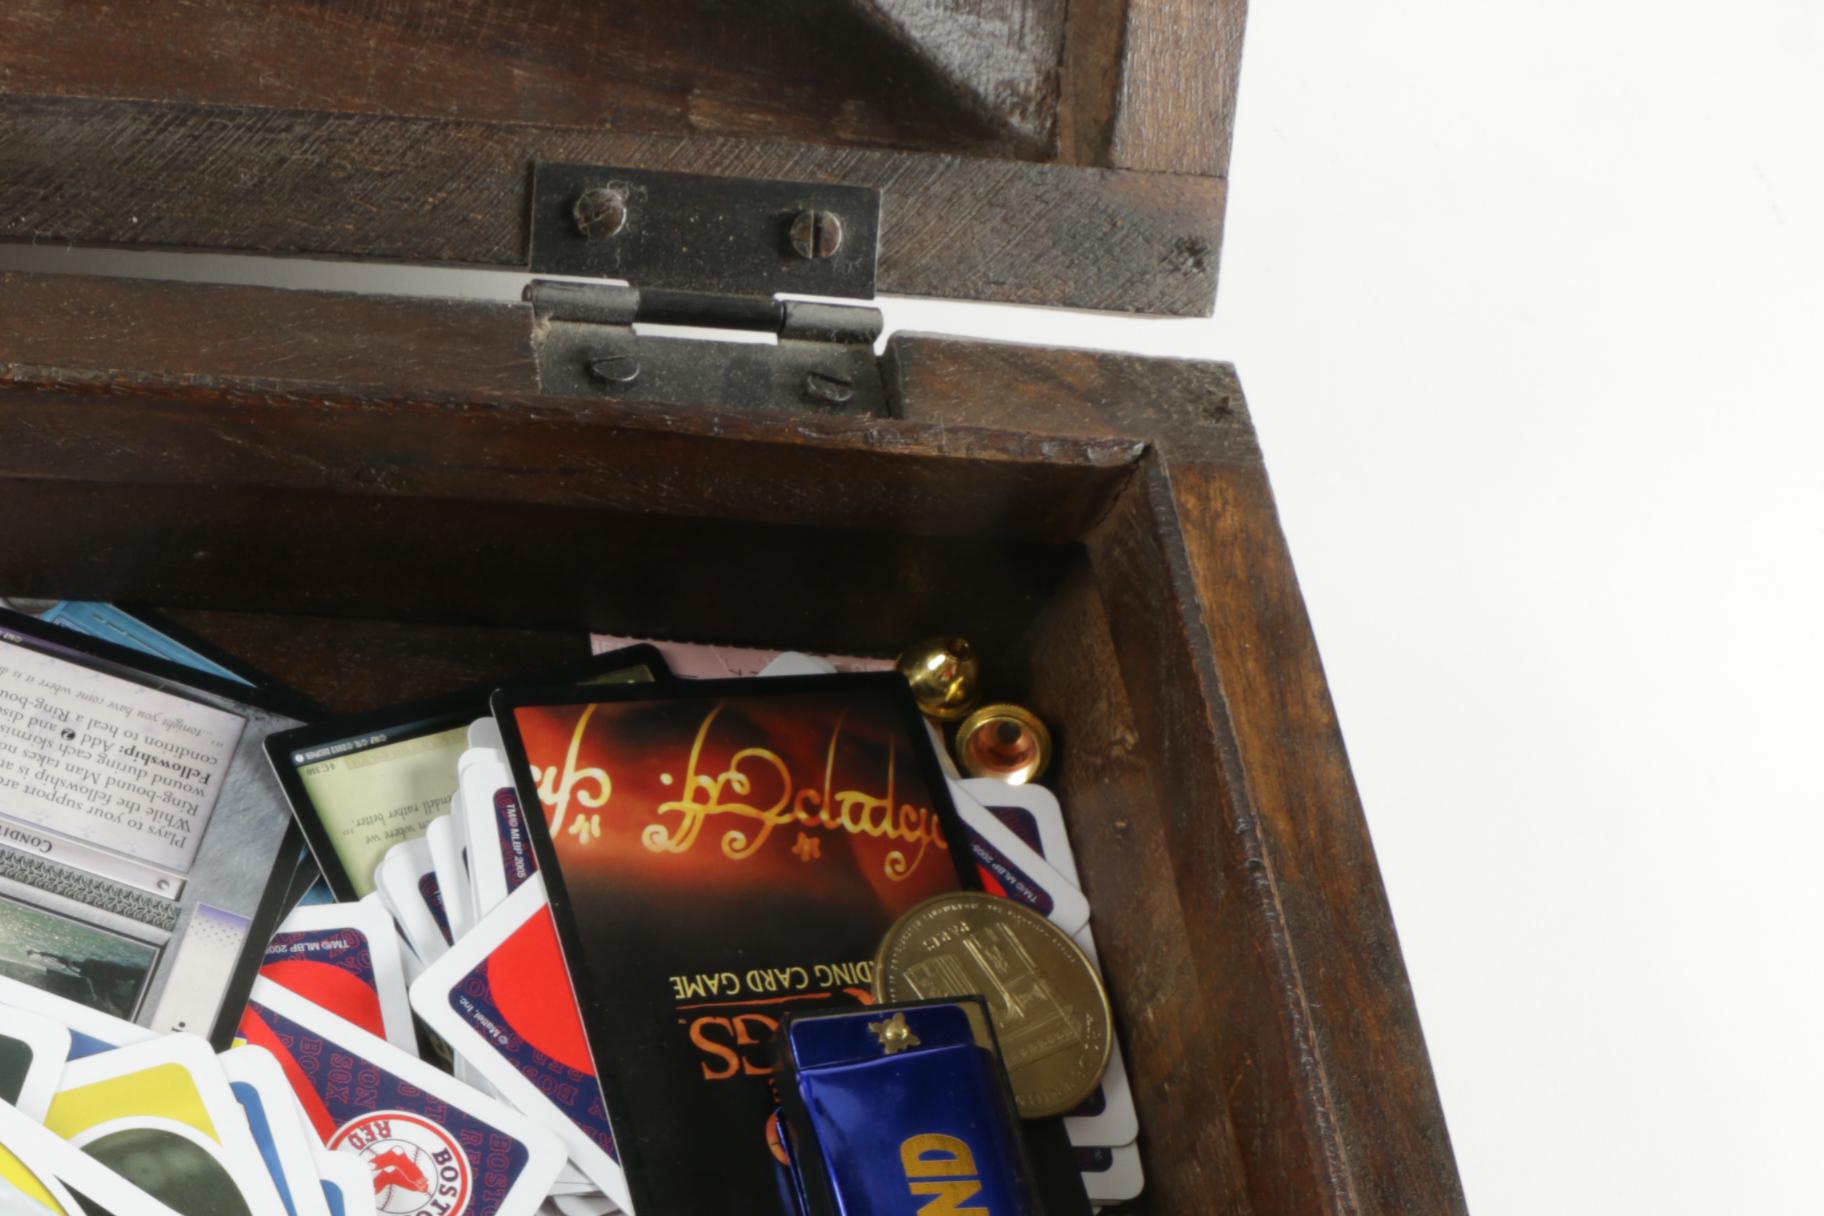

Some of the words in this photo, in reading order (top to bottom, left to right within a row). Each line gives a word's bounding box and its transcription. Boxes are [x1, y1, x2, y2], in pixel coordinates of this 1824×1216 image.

[38, 680, 71, 695] where
[75, 691, 104, 704] come
[106, 702, 133, 718] have
[137, 710, 160, 723] you
[27, 717, 57, 731] and
[86, 718, 119, 738] heal
[80, 734, 115, 753] Add
[123, 730, 138, 741] to
[23, 750, 60, 768] takes
[58, 743, 92, 760] each
[145, 736, 218, 770] condition
[0, 759, 14, 770] at
[18, 766, 30, 779] is
[65, 763, 101, 784] Man
[96, 753, 148, 782] during
[120, 746, 212, 786] Fellowship:
[34, 769, 112, 806] fellowship
[151, 774, 205, 798] wound
[23, 784, 83, 810] support
[105, 777, 200, 819] Ring-bound
[117, 798, 141, 814] the
[86, 806, 124, 824] your
[146, 808, 190, 833] While
[127, 819, 143, 831] to
[149, 826, 187, 849] Plays
[669, 971, 741, 999] GAME
[746, 966, 809, 993] CARD
[347, 1120, 393, 1151] RED
